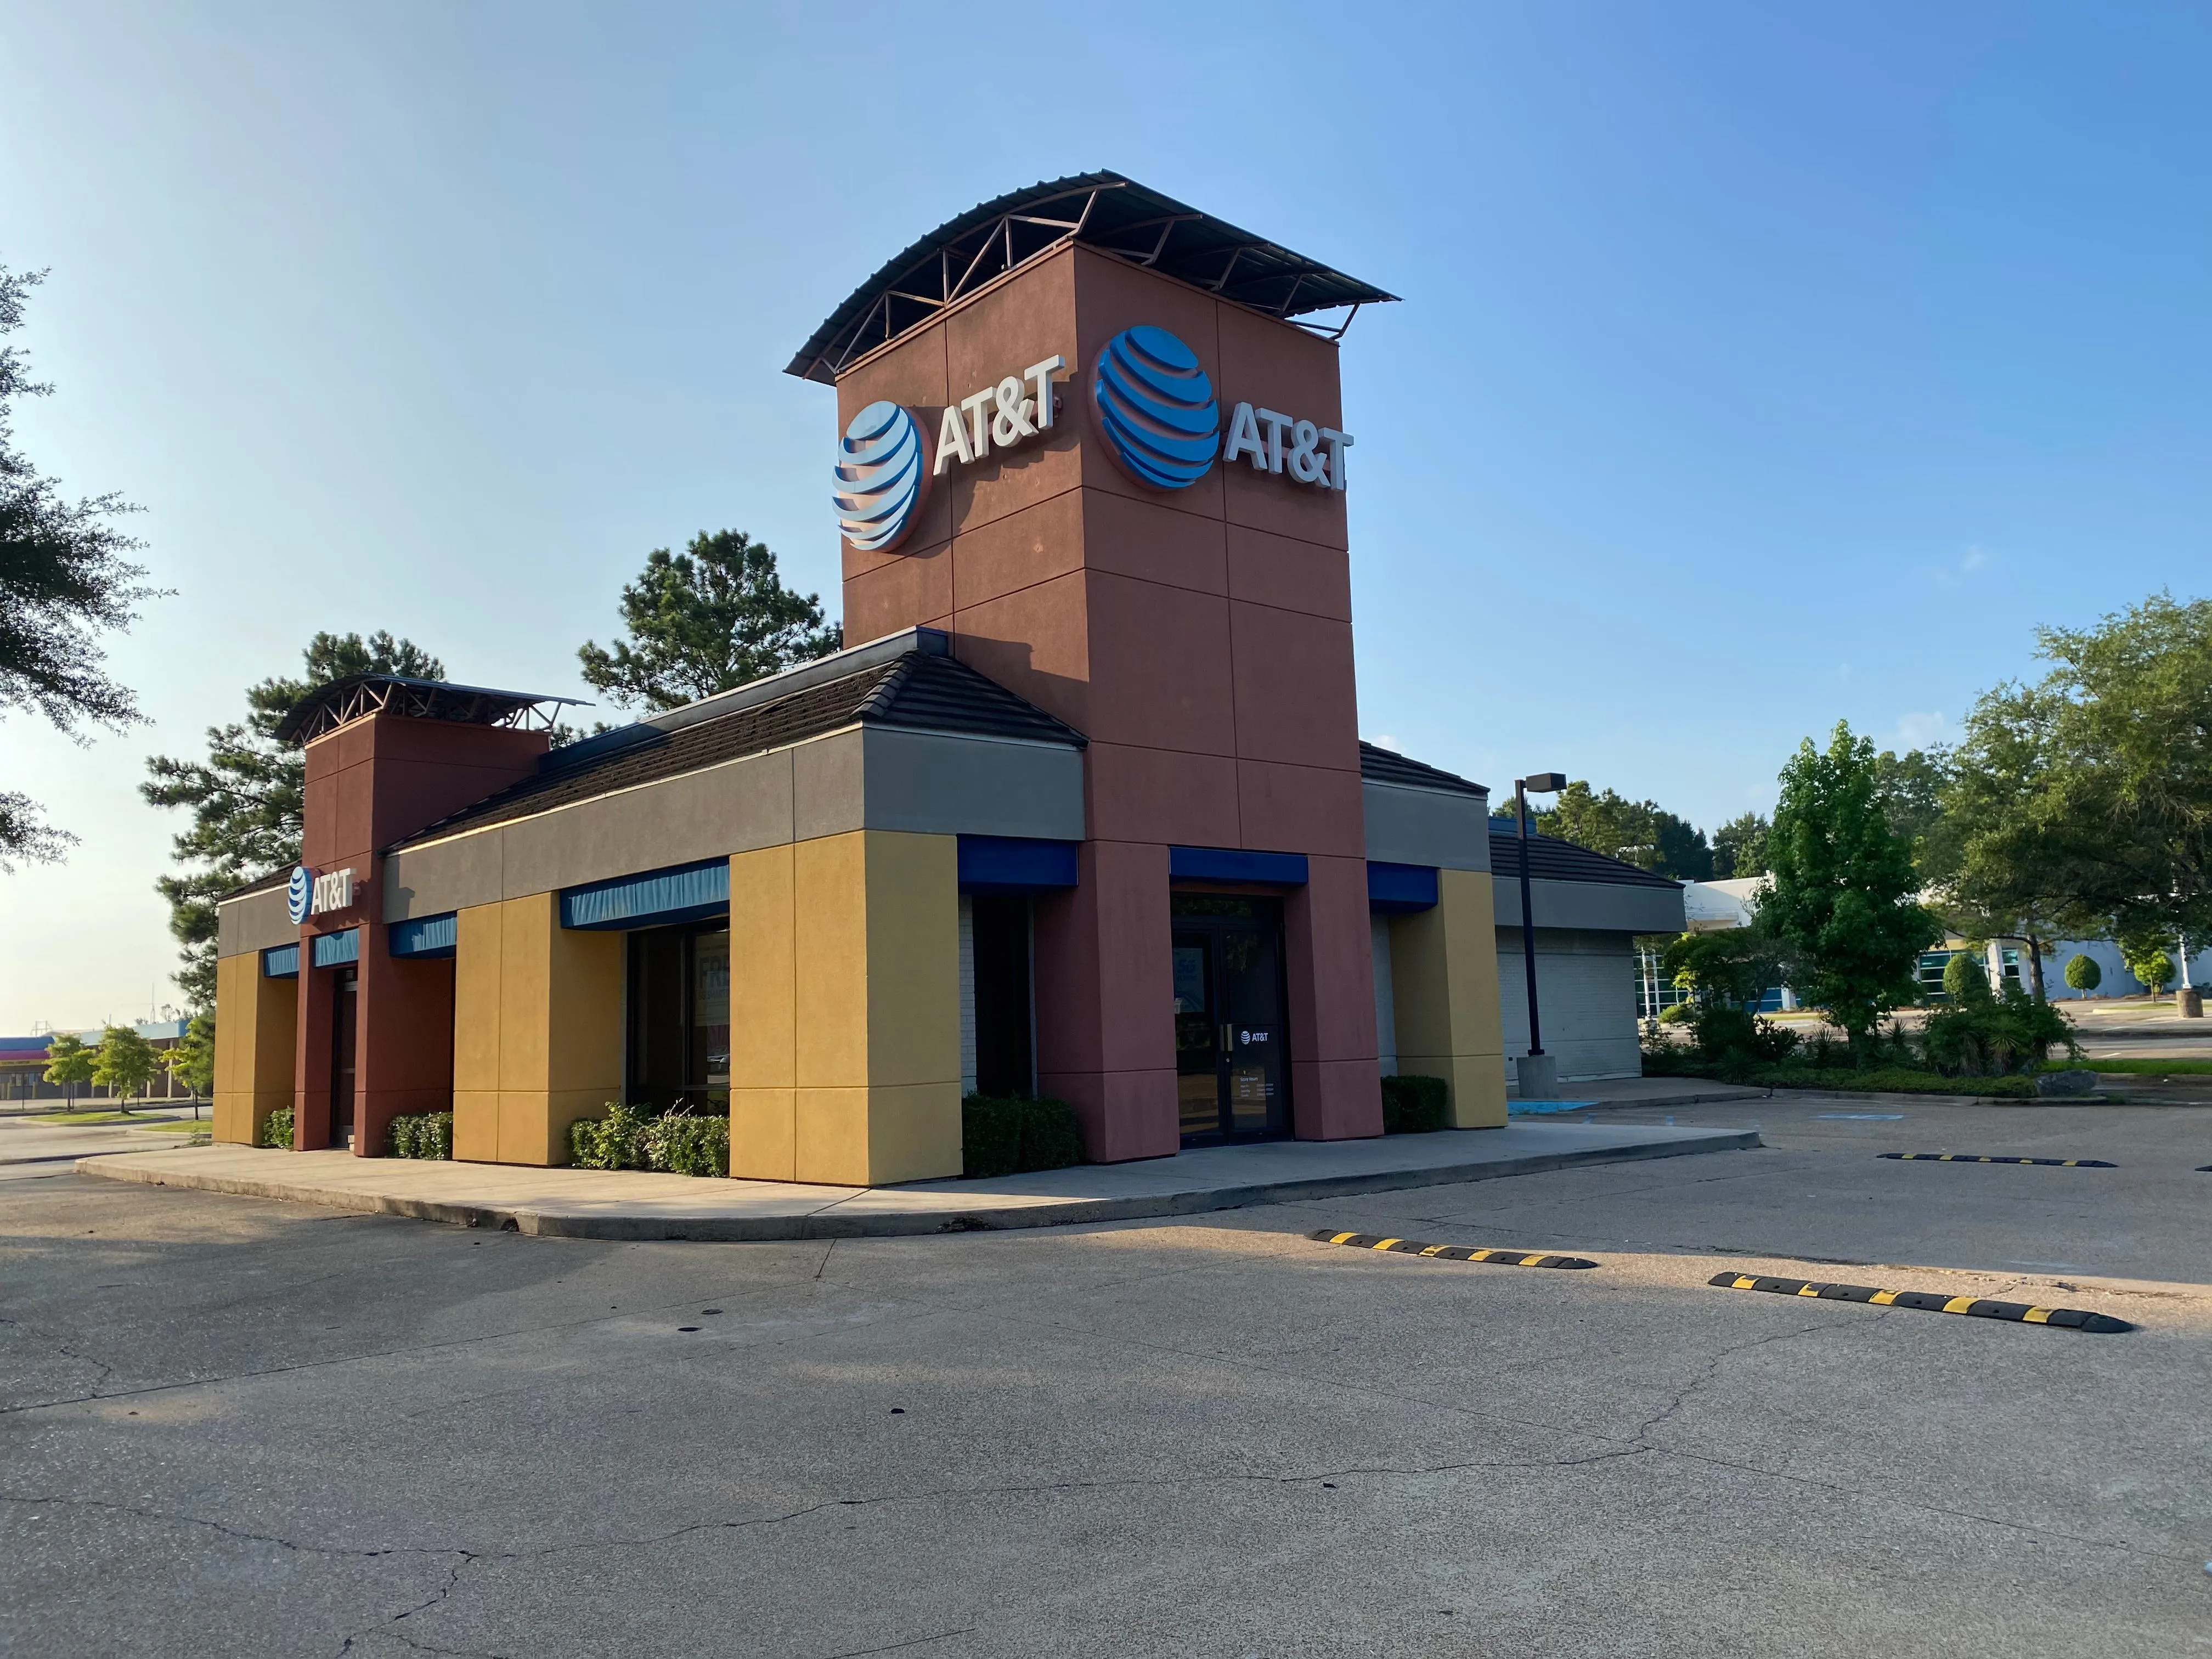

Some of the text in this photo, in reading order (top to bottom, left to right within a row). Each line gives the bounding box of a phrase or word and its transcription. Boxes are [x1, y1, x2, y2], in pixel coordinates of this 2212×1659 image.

[933, 354, 1065, 476] AT&T
[1222, 401, 1354, 490] AT&T
[311, 867, 356, 915] AT&T
[1251, 1032, 1268, 1042] AT&T
